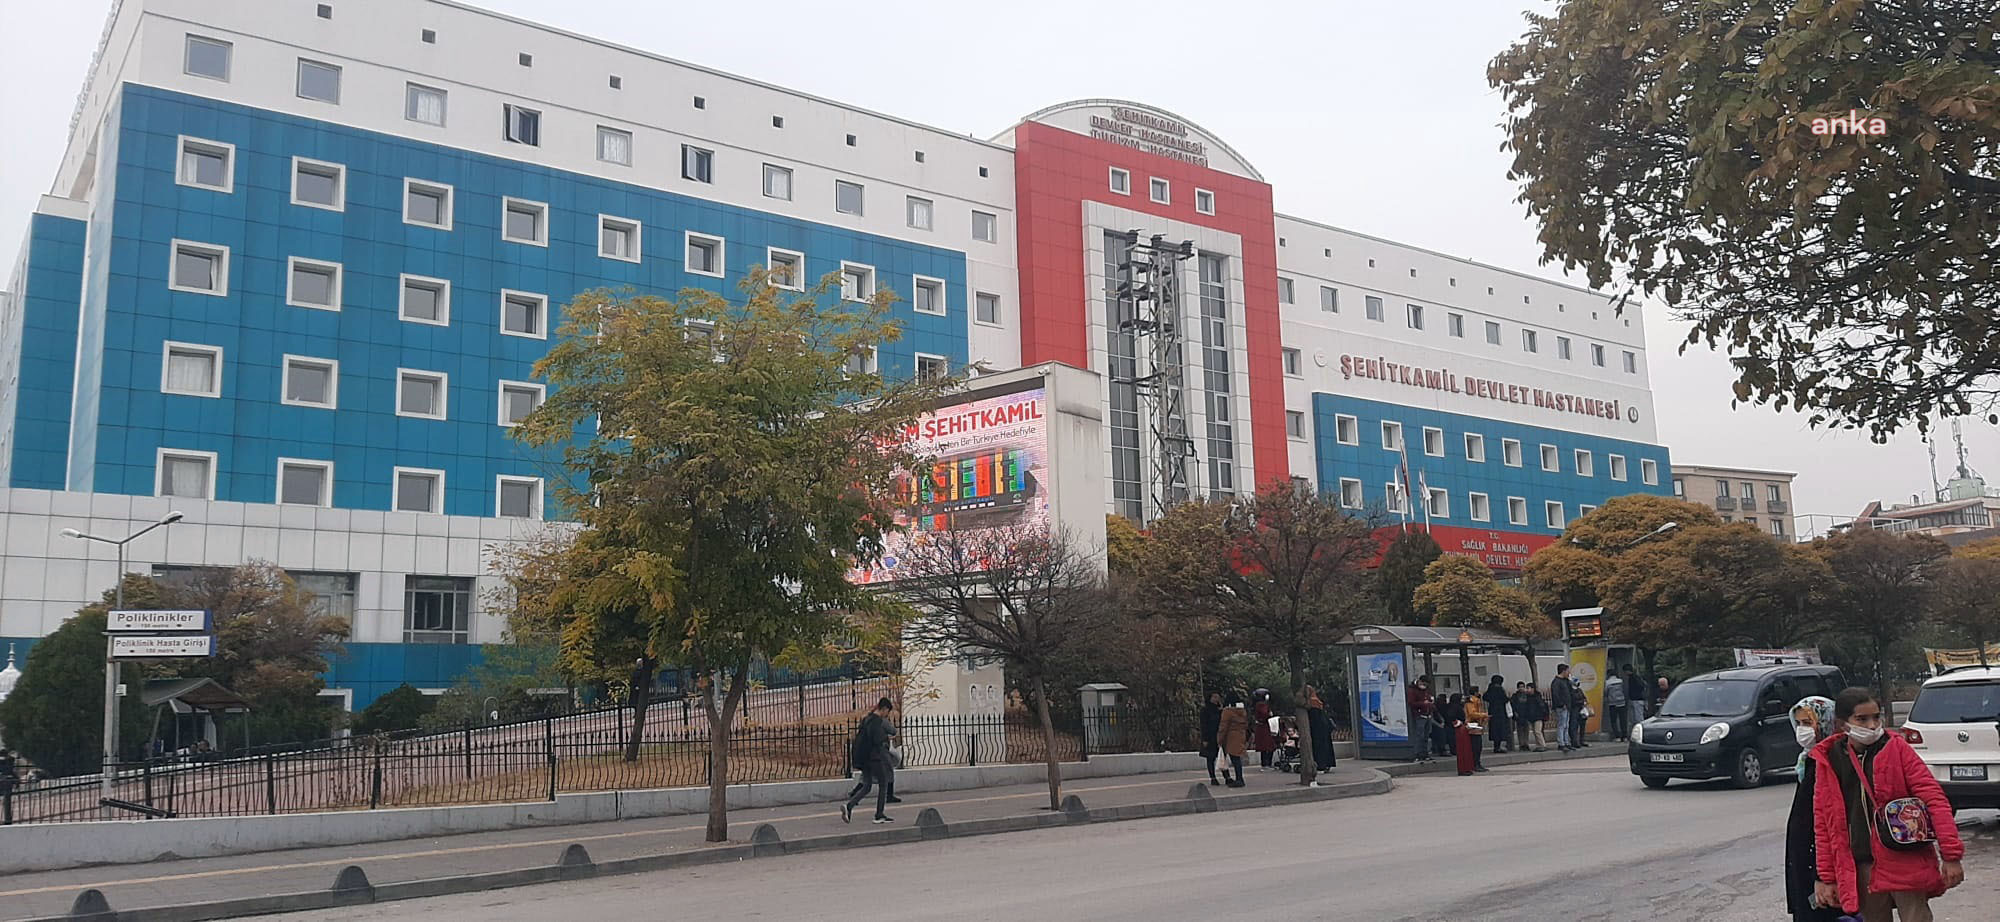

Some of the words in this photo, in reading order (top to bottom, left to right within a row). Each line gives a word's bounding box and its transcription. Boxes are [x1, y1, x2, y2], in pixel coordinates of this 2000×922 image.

[1091, 115, 1133, 137] DEVLET
[1140, 128, 1207, 155] HASTANESİ
[1340, 354, 1460, 394] ŞEHİTKAMİL
[1465, 376, 1530, 405] DEVLET
[1533, 389, 1621, 421] HASTANESİ
[117, 613, 193, 623] Poliklinikler
[115, 639, 154, 648] Poliklinik
[156, 638, 180, 647] Hasta
[183, 638, 207, 648] Girişi
